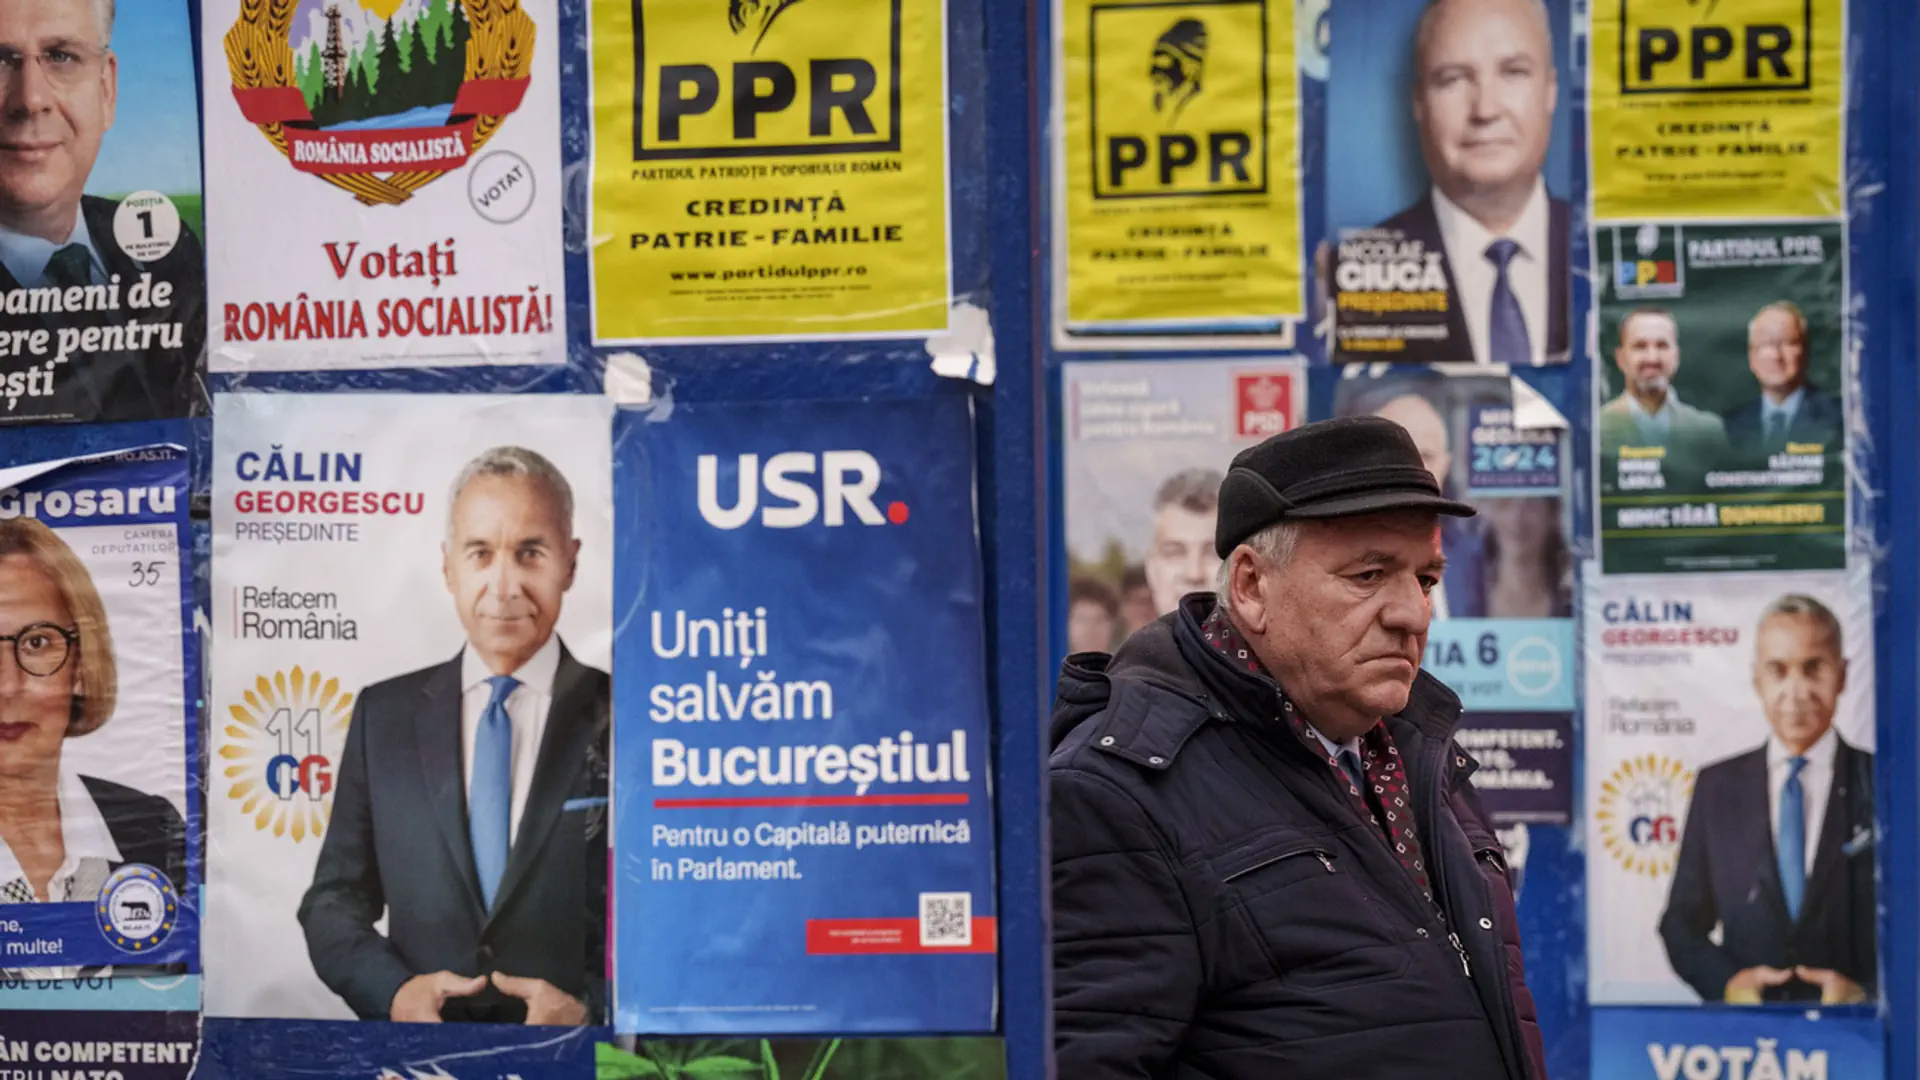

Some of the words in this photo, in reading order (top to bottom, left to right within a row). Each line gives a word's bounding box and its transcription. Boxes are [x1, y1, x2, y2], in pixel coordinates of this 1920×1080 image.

[1637, 24, 1794, 82] PPR
[657, 58, 878, 141] PPR
[293, 136, 368, 164] ROMÂNIA
[370, 131, 466, 164] SOCIALISTĂ
[1107, 131, 1251, 187] PPR
[477, 164, 525, 209] VOTAT
[632, 167, 695, 181] PARTIDUL
[771, 162, 847, 177] POPORULUI
[851, 159, 902, 174] ROMÂN
[686, 190, 846, 221] CREDINȚĂ
[136, 211, 153, 238] 1
[321, 236, 458, 291] Votați
[670, 264, 868, 282] www.partidulppr.ro
[1335, 251, 1449, 291] CIUCĂ
[0, 274, 120, 316] ameni
[128, 272, 174, 308] de
[223, 292, 369, 342] ROMÂNIA
[377, 285, 554, 339] SOCIALISTĂ!
[54, 318, 184, 363] pentru
[0, 360, 55, 411] ști
[236, 444, 363, 483] CĂLIN
[1471, 445, 1557, 473] 2024
[0, 485, 177, 520] Grosaru
[235, 491, 425, 516] GEORGESCU
[697, 450, 910, 531] USR.
[124, 529, 175, 541] CAMERA
[235, 522, 359, 544] PREȘEDINTE
[128, 561, 167, 588] 35
[243, 586, 337, 610] Refacem
[1602, 598, 1694, 623] CĂLIN
[243, 611, 358, 642] România
[650, 607, 768, 670] Uniți
[1601, 628, 1740, 647] GEORGESCU
[1477, 633, 1499, 667] 6
[649, 670, 833, 724] salvăm
[651, 729, 971, 797] Bucureștiul
[651, 824, 729, 848] Pentru
[733, 827, 750, 846] o
[754, 820, 851, 852] Capitală
[856, 818, 970, 850] puternică
[651, 857, 673, 881] în
[678, 857, 803, 881] Parlament.
[7, 938, 63, 955] multe!
[1646, 1036, 1829, 1080] VOTĂM
